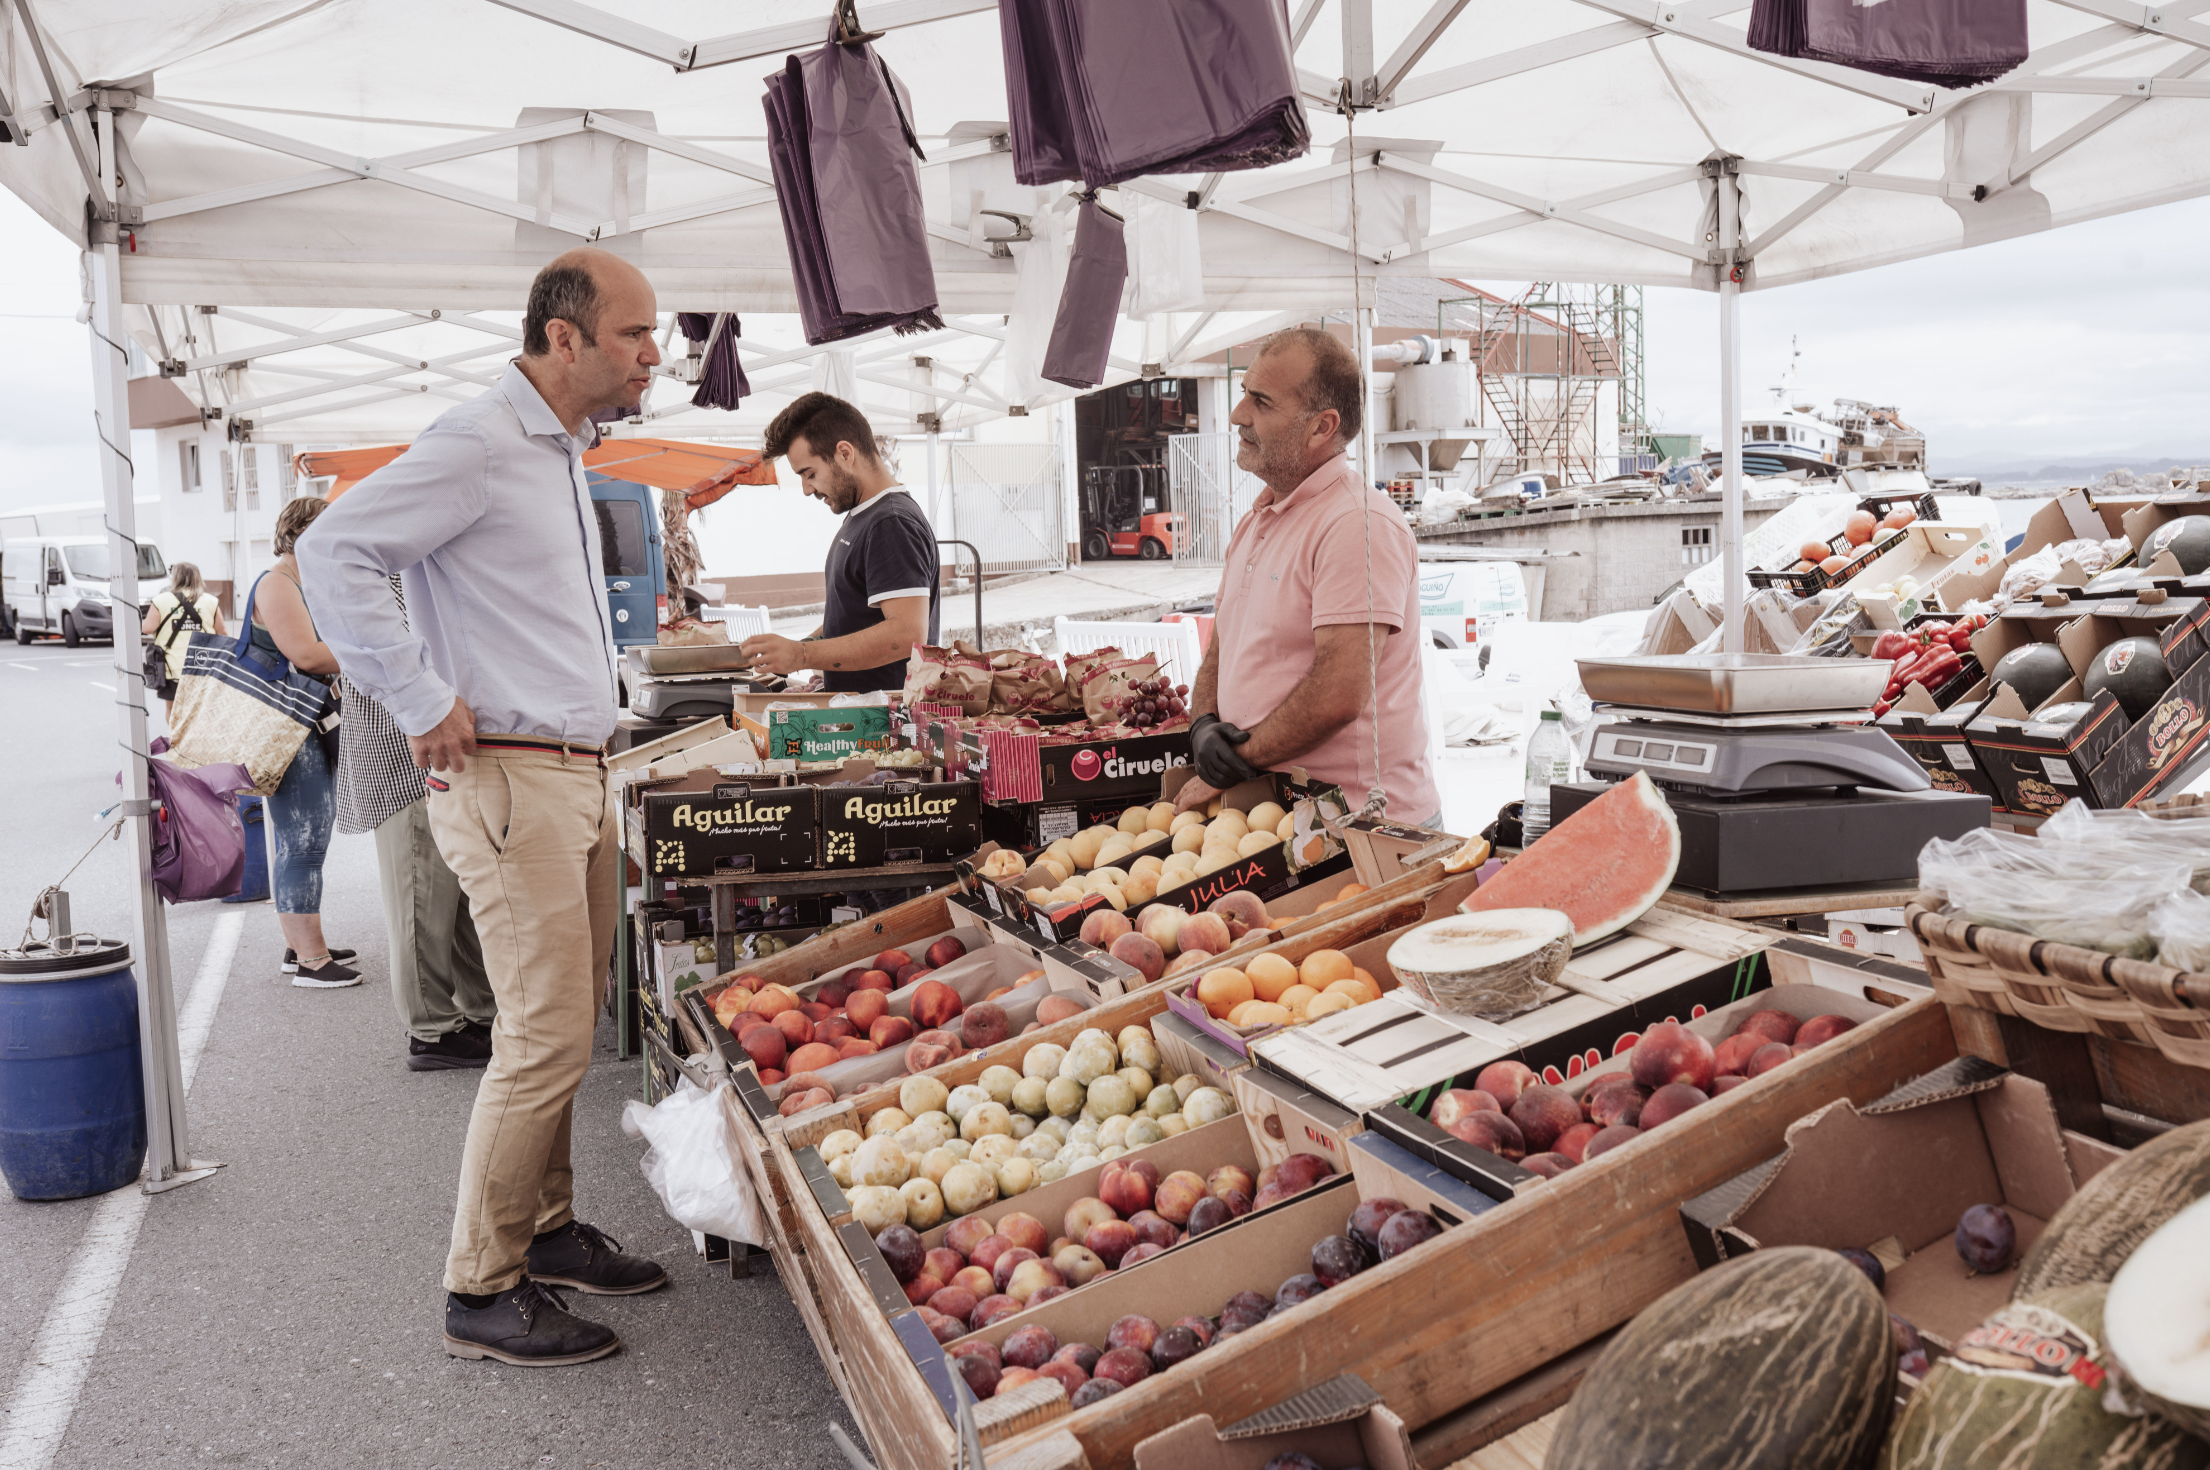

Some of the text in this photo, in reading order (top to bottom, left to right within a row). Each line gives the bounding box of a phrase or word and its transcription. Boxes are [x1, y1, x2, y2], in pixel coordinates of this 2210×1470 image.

[1931, 569, 1955, 589] Frutas
[2097, 604, 2129, 612] BOLLO
[937, 690, 975, 701] Ciruelo
[2156, 708, 2189, 747] BOLLO
[1103, 746, 1116, 760] el
[1104, 752, 1187, 779] Ciruelo
[673, 799, 792, 832] Aguilar
[844, 792, 957, 825] Aguilar
[1188, 861, 1267, 916] JULIA
